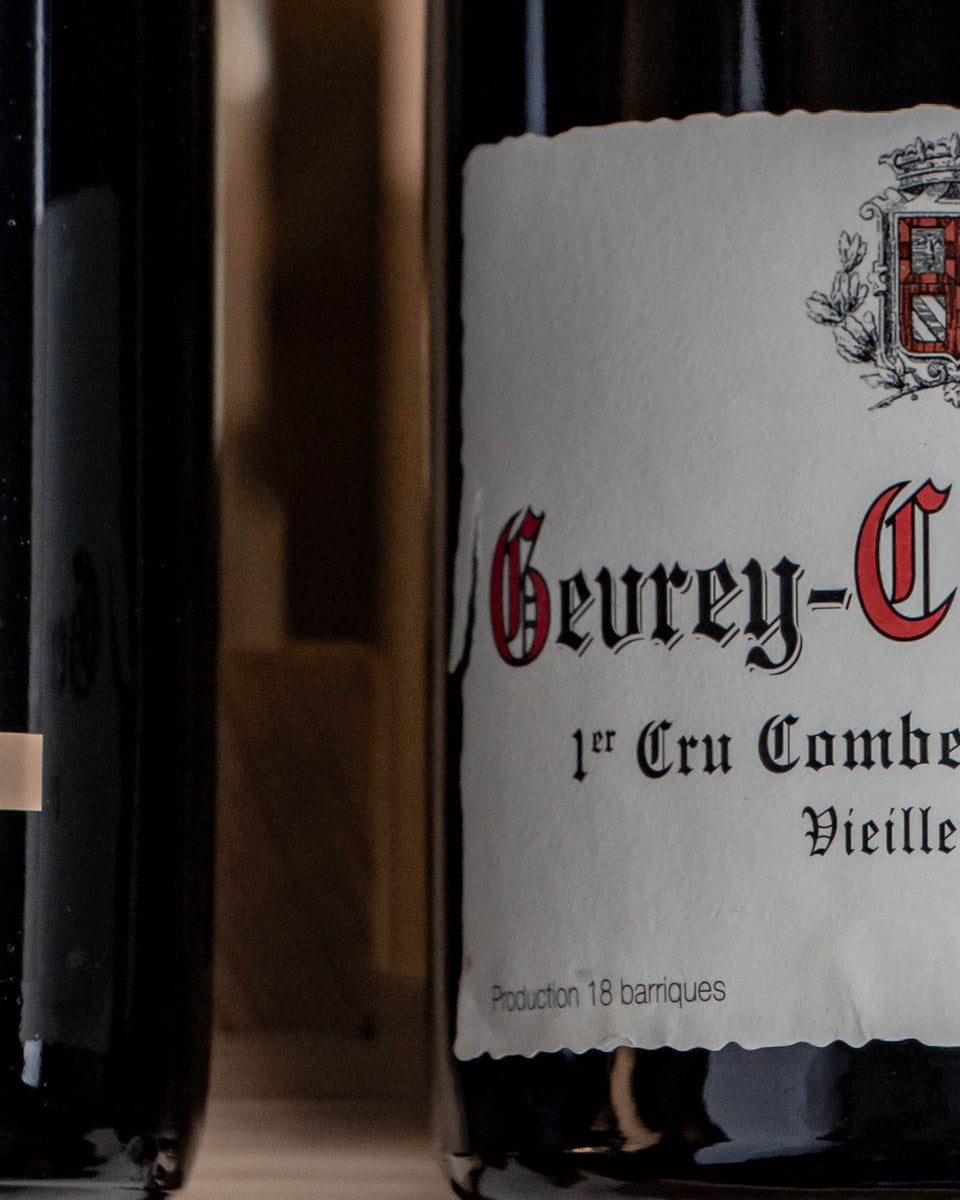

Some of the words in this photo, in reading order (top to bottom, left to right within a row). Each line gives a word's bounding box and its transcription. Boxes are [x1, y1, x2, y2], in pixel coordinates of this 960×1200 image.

[636, 718, 733, 779] Cru
[801, 804, 958, 857] Vieille
[491, 980, 580, 1013] Production
[587, 978, 613, 1007] 18
[619, 976, 727, 1010] barriques
